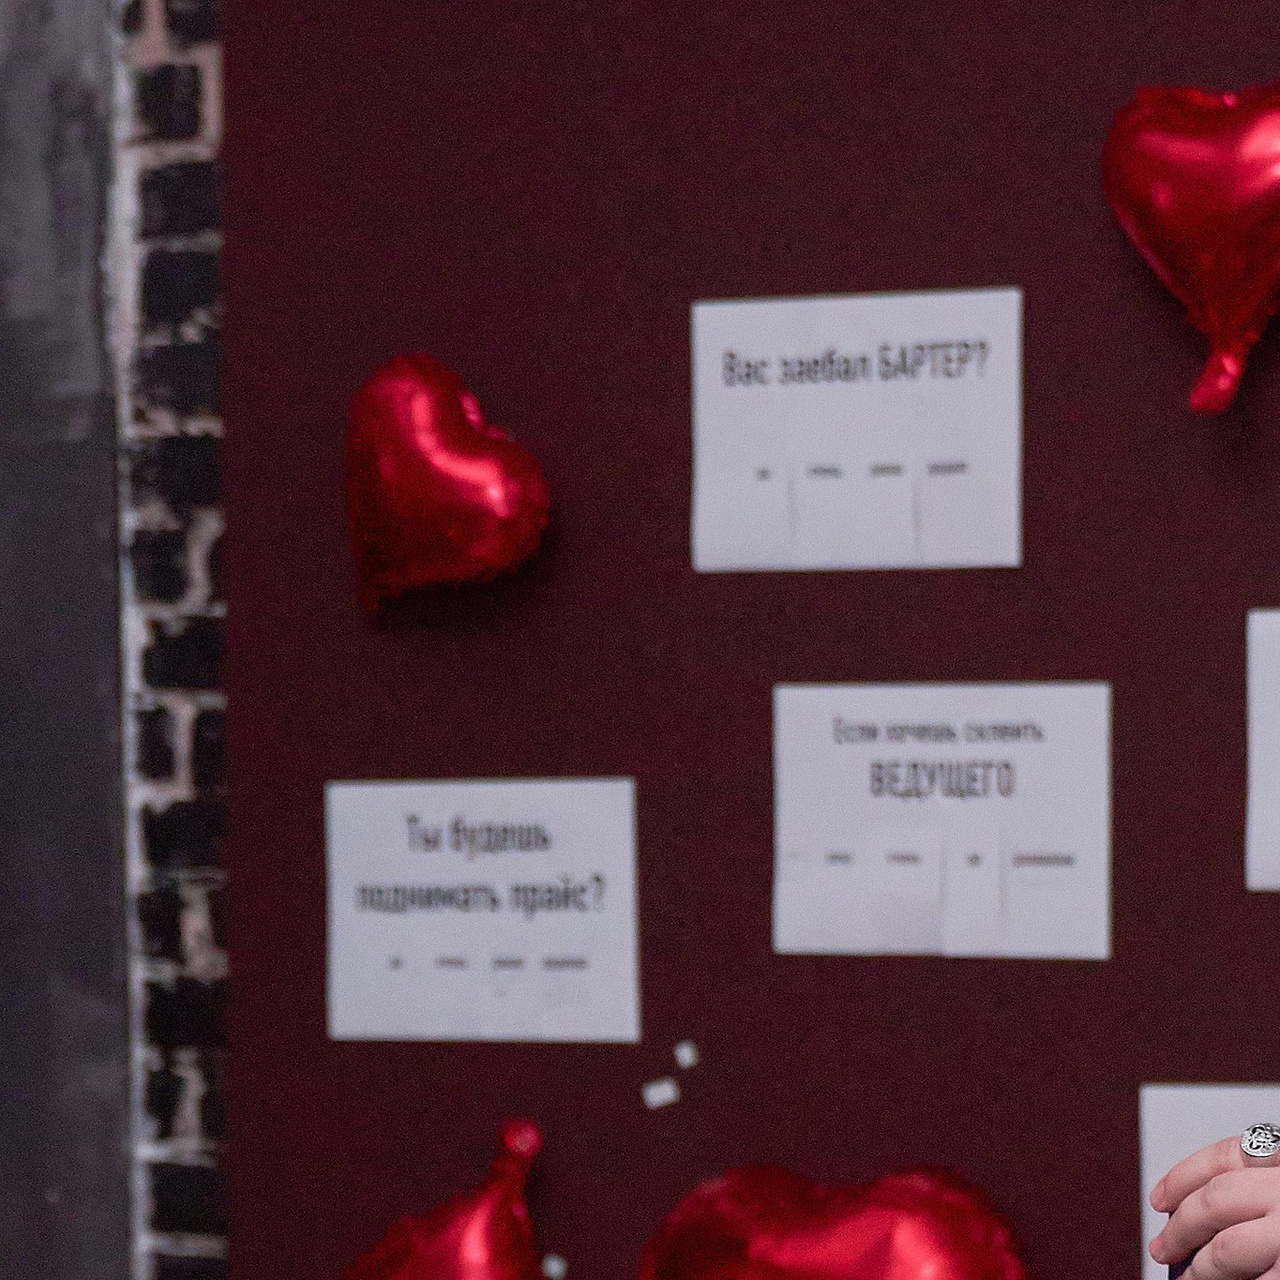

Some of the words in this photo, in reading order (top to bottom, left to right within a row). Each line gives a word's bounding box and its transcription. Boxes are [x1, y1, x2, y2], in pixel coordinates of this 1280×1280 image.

[722, 349, 769, 388] Вас
[877, 339, 990, 382] БАРТЕР?
[869, 759, 1016, 802] ВЕДУЩЕГО
[405, 813, 443, 853] Ты
